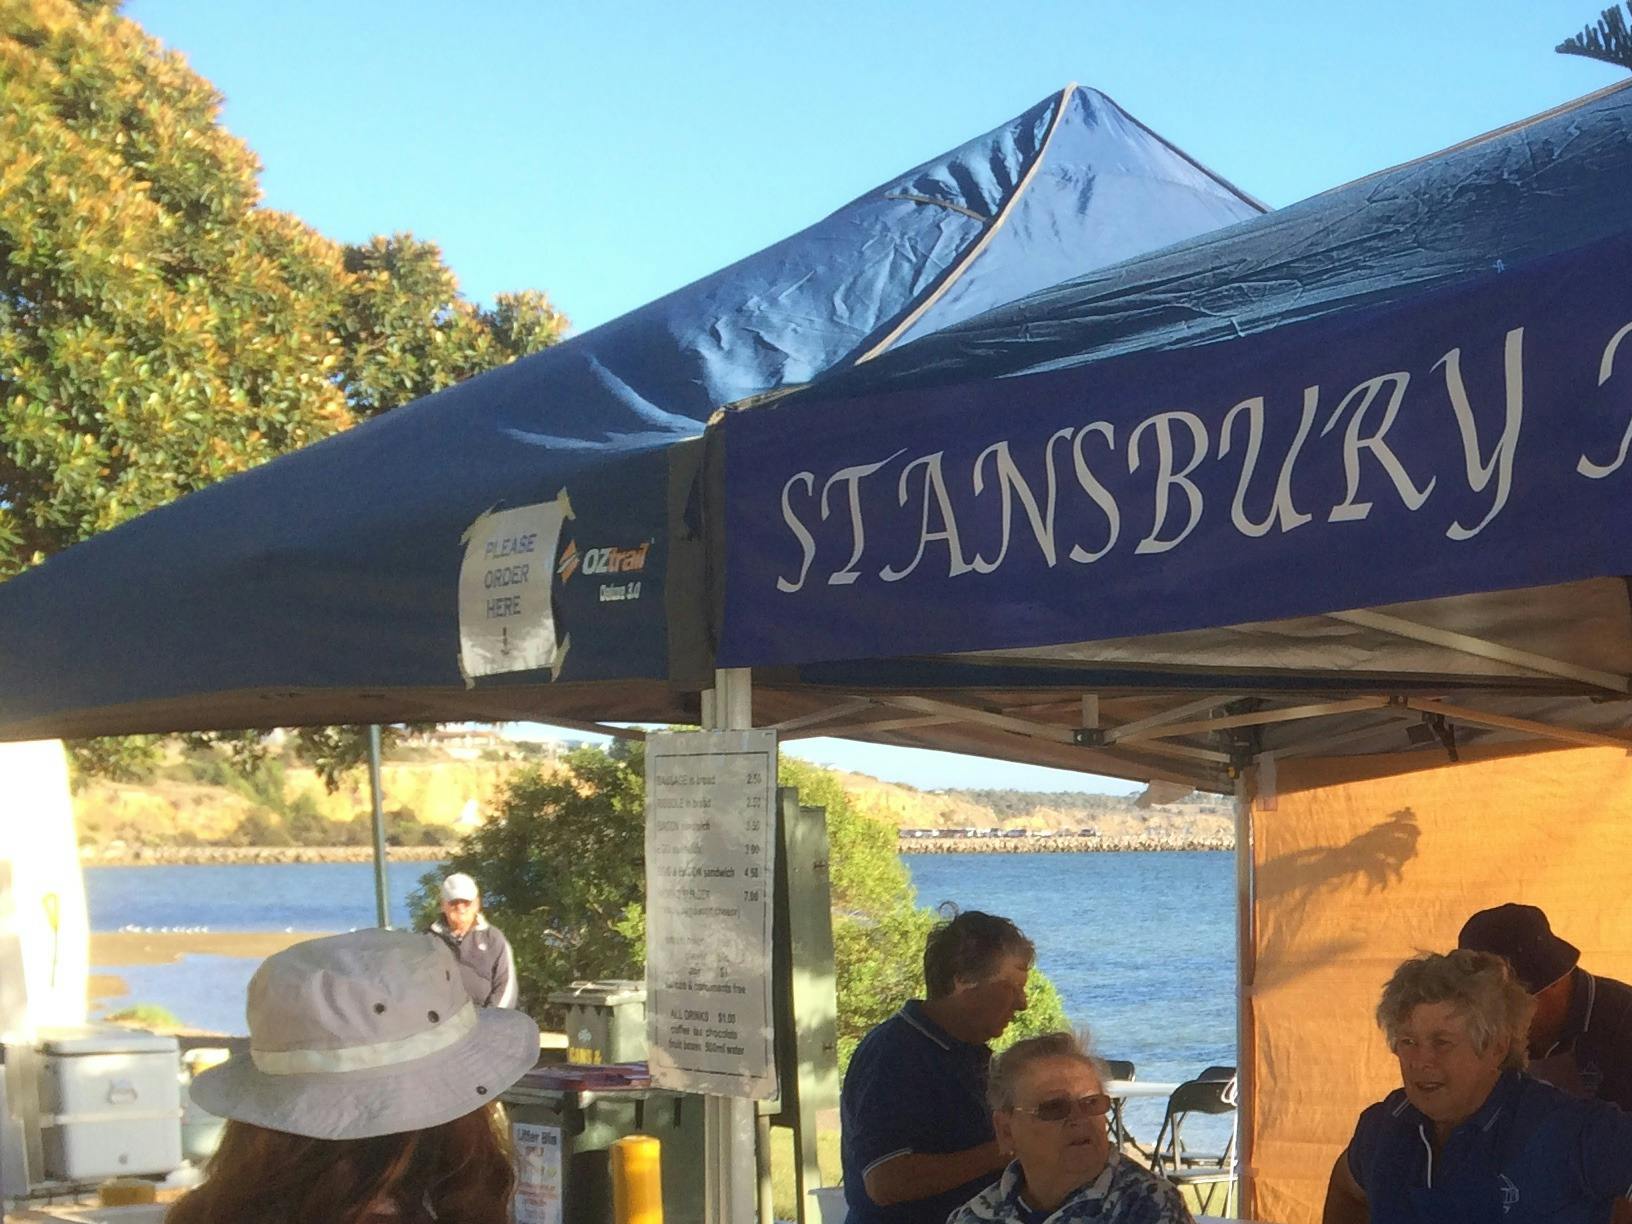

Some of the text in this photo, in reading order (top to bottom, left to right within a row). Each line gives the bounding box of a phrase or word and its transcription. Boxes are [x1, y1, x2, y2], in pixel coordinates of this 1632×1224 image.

[774, 327, 1525, 594] STANSBURY
[485, 533, 538, 560] PLEASE
[484, 564, 529, 589] ORDER
[486, 595, 521, 618] HERE
